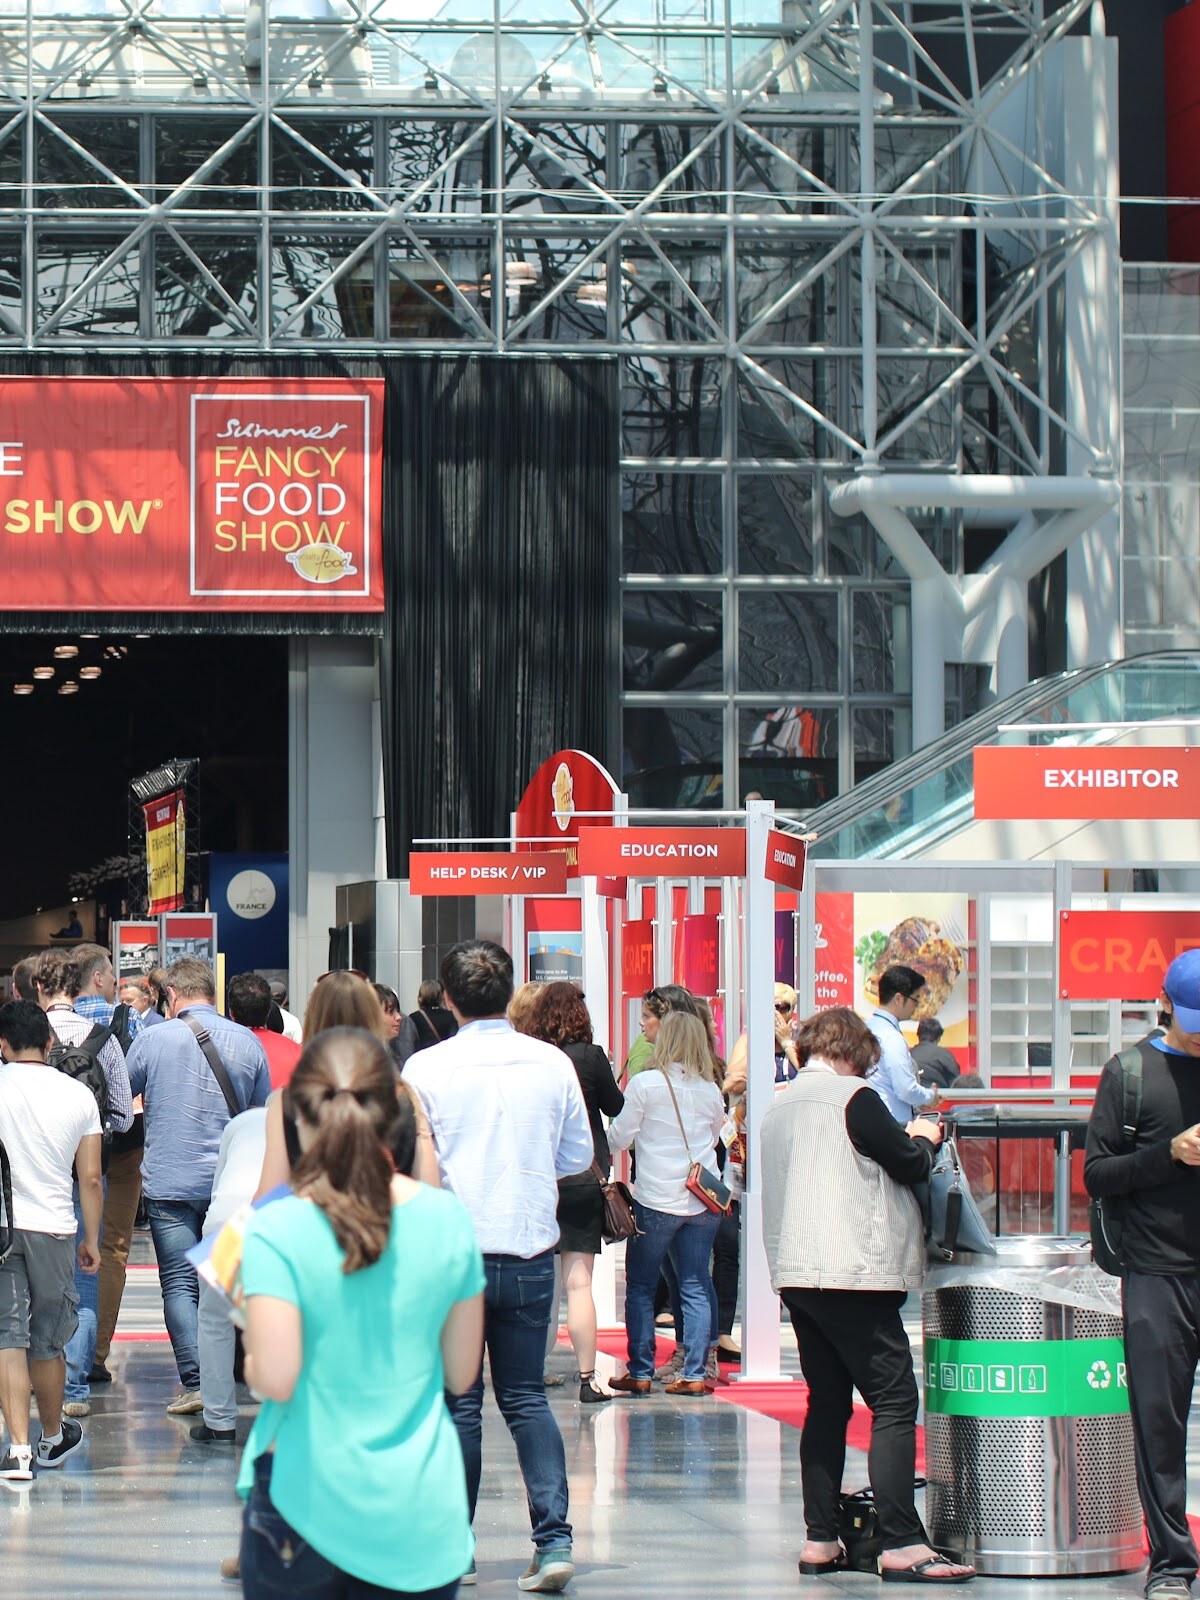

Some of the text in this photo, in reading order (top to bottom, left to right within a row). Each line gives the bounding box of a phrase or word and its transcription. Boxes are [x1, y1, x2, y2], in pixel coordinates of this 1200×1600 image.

[216, 418, 348, 439] Summer
[215, 446, 347, 478] FANCY
[215, 482, 346, 516] FOOD
[315, 548, 351, 580] food
[1044, 769, 1179, 788] EXHIBITOR
[620, 844, 719, 857] EDUCATION
[774, 849, 797, 868] EDUCATION
[430, 866, 547, 880] HELP DESK / VIP
[624, 943, 652, 975] CRAFT
[817, 986, 838, 998] the
